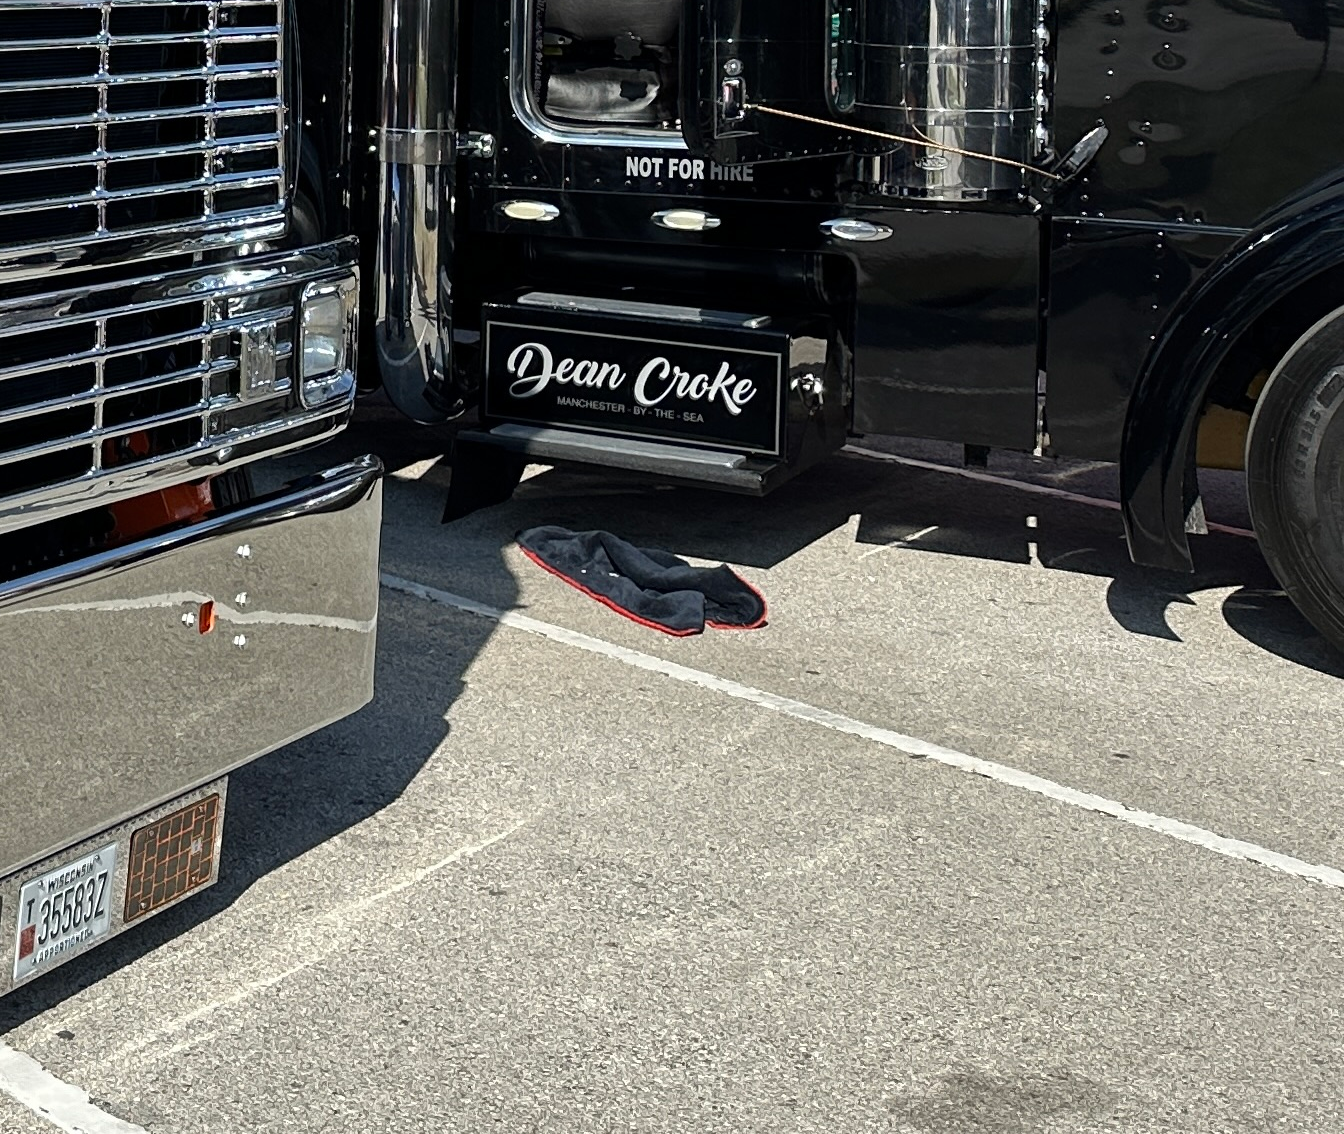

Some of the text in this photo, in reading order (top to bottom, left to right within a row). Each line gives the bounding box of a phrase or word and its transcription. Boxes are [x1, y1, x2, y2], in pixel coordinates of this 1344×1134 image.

[626, 156, 754, 182] NOT FOR HIRE
[507, 342, 758, 416] Dean Croke
[556, 396, 626, 413] MANCHESTER
[633, 406, 648, 415] BY
[654, 408, 675, 420] THE
[682, 411, 705, 423] SEA
[47, 862, 94, 893] WISCONSIN
[27, 870, 109, 945] T 35583Z
